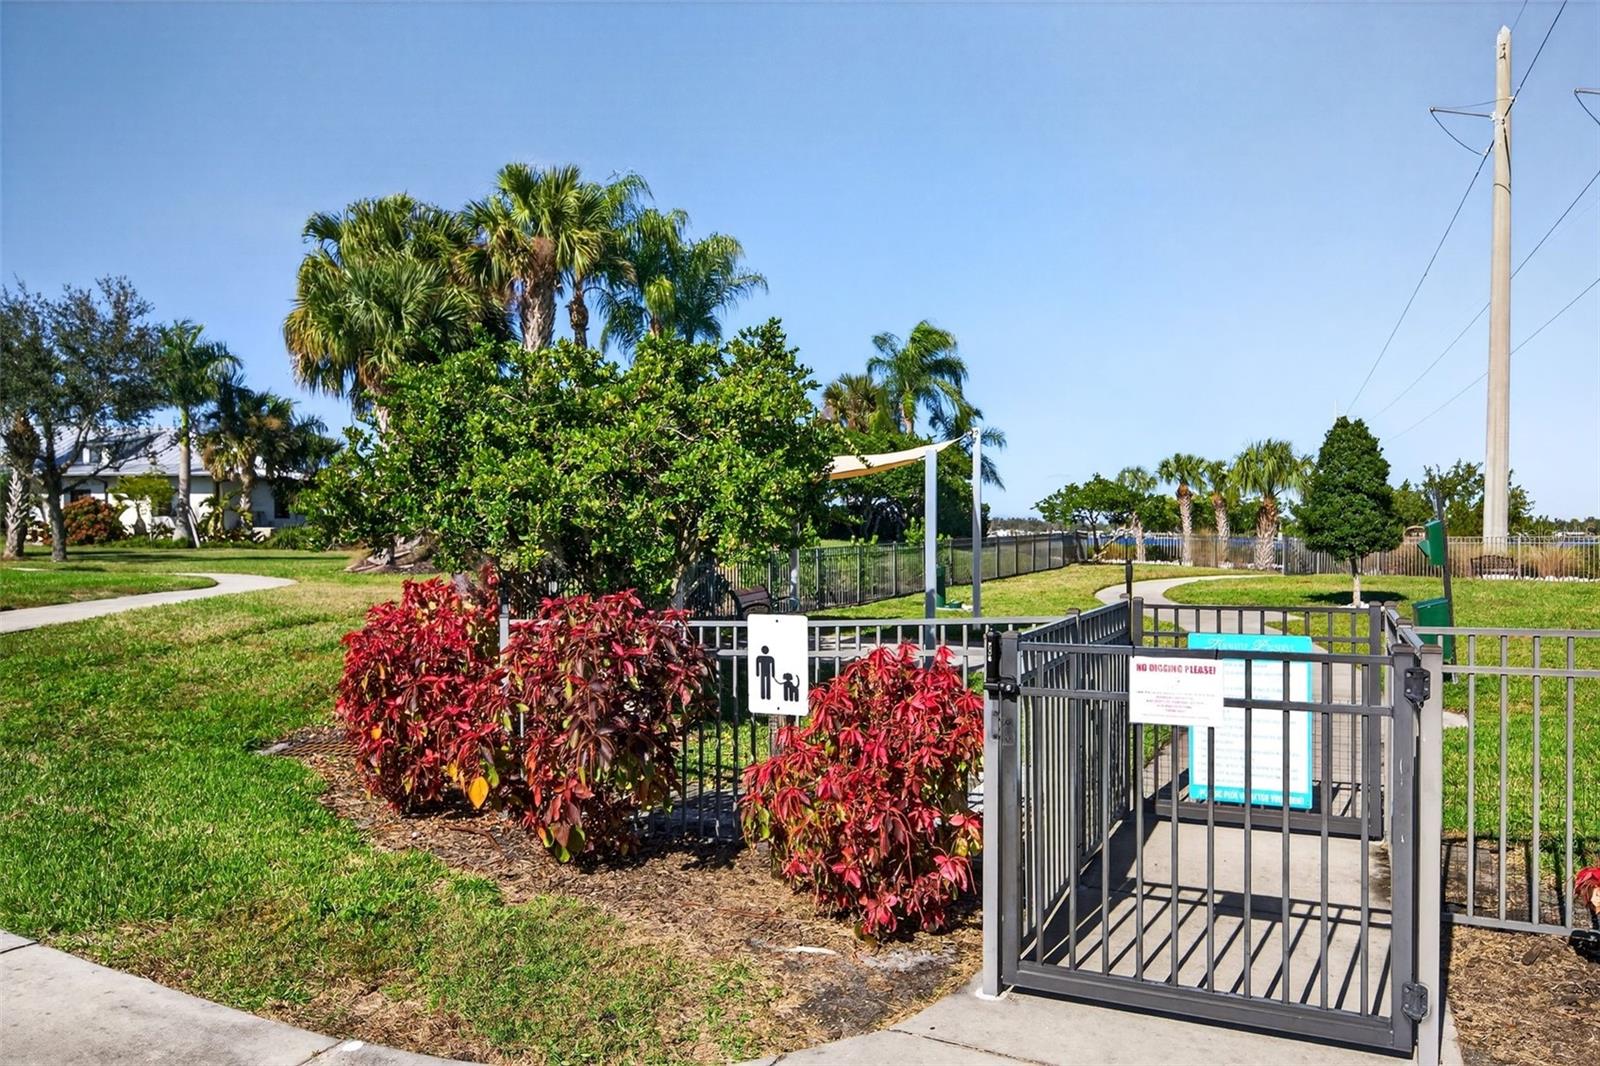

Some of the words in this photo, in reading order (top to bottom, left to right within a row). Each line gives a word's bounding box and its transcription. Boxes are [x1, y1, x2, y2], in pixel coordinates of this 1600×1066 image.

[1136, 663, 1147, 672] NO
[1149, 664, 1182, 673] DIGGING
[1184, 665, 1216, 675] PLEASE!
